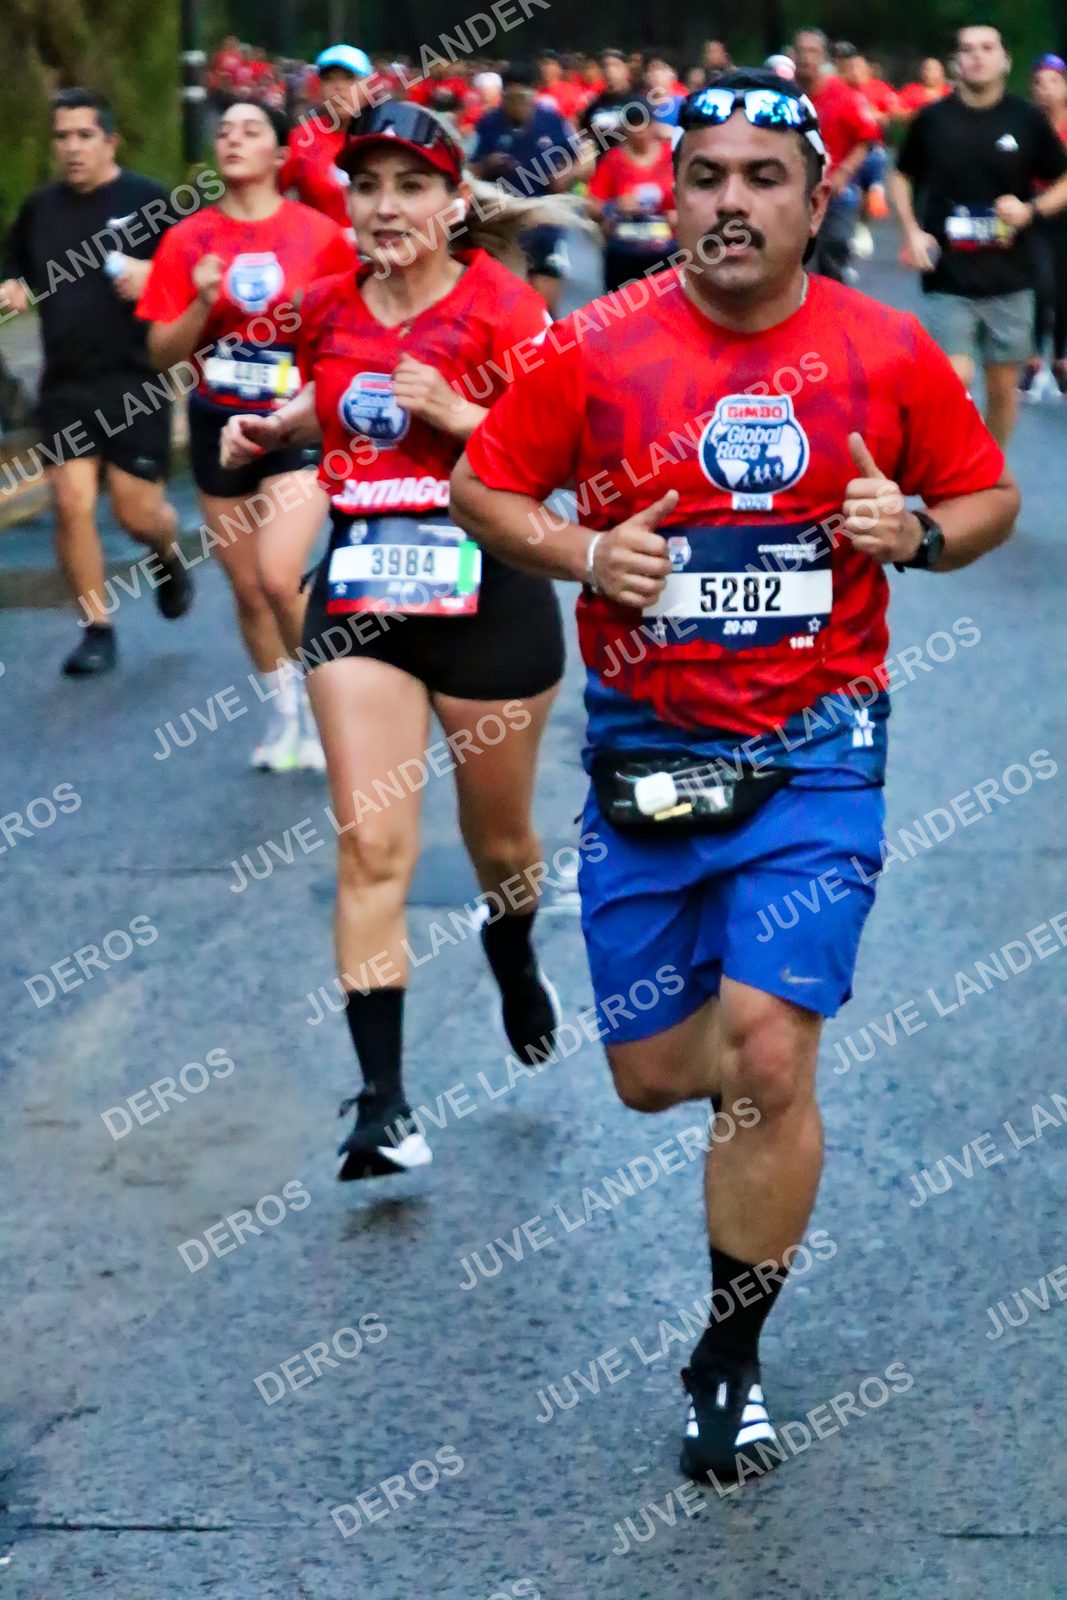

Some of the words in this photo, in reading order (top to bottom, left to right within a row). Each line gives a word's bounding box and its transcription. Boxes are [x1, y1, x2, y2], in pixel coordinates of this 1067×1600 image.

[727, 425, 782, 444] Global
[716, 441, 761, 460] Race
[371, 549, 435, 577] 3984
[701, 577, 781, 613] 5282
